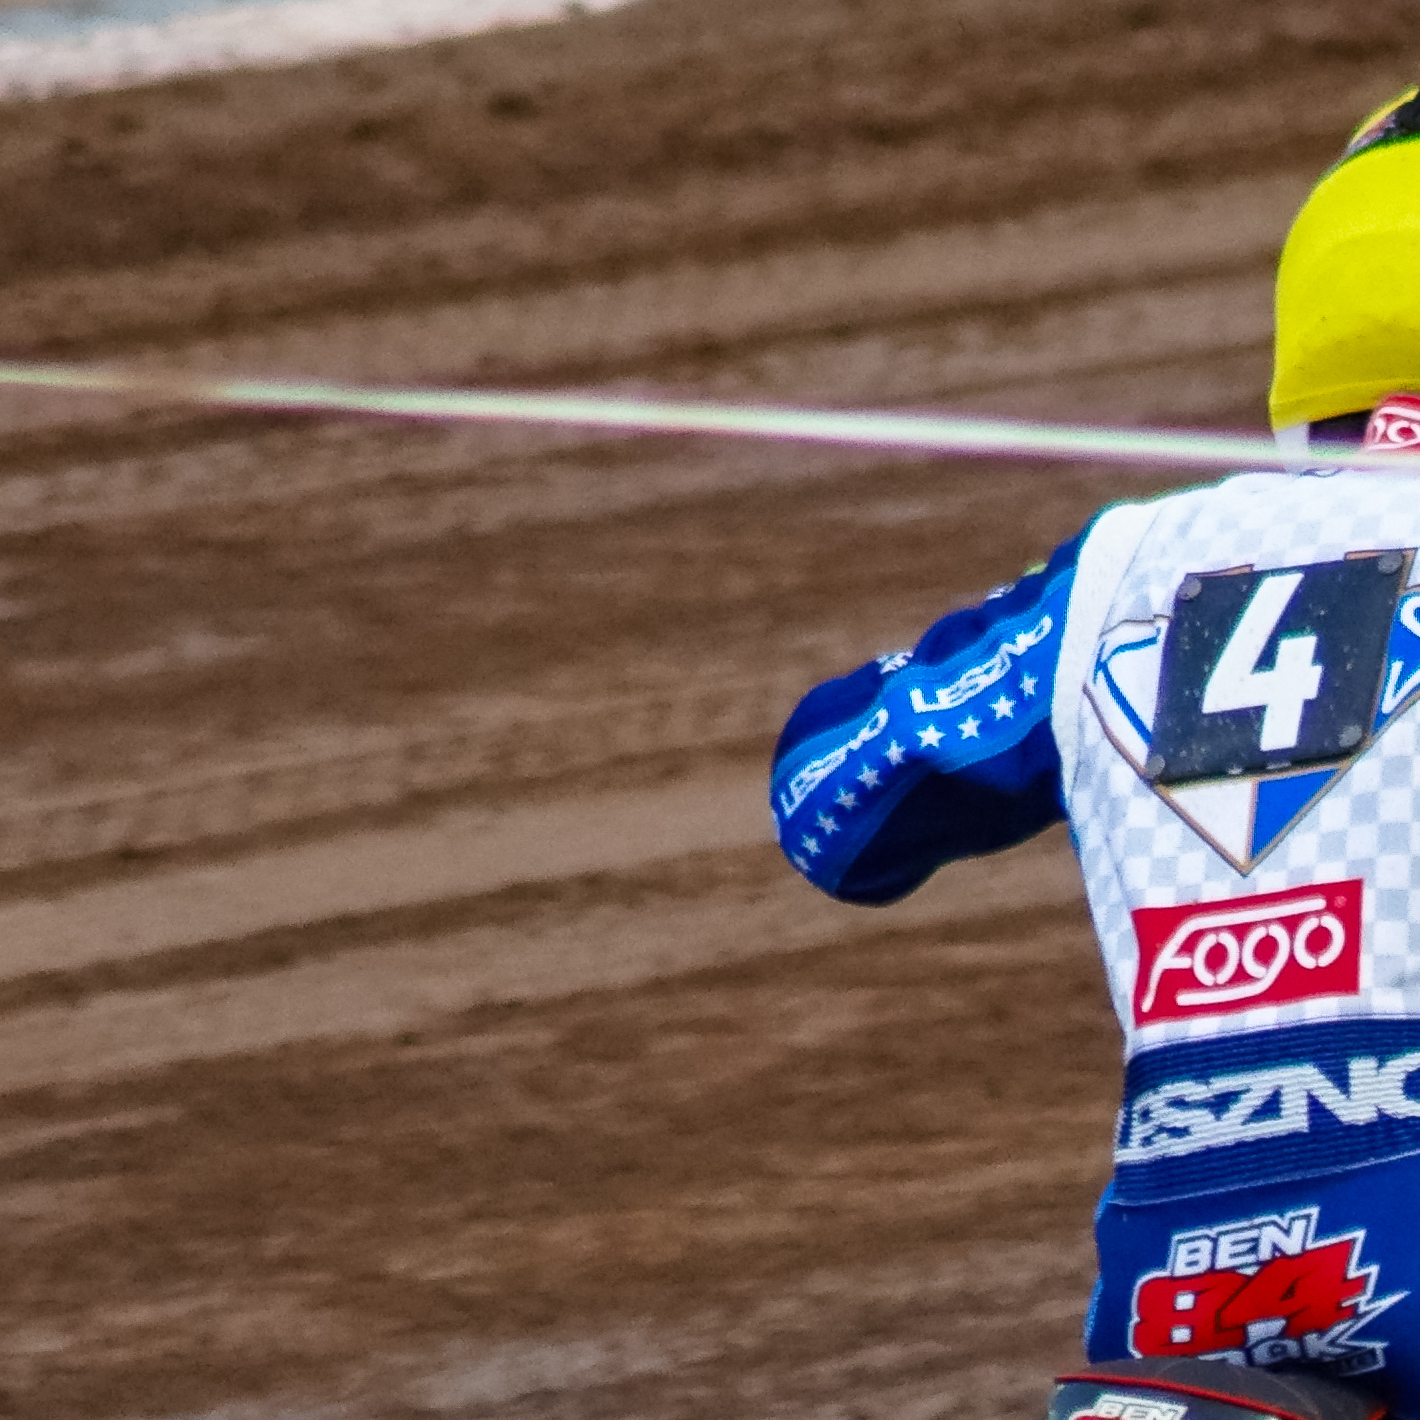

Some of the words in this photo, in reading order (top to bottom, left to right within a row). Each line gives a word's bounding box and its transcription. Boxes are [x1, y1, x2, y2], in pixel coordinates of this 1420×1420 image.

[1201, 574, 1323, 752] 4
[1132, 1238, 1368, 1357] 84
[1173, 1217, 1310, 1277] BEN
